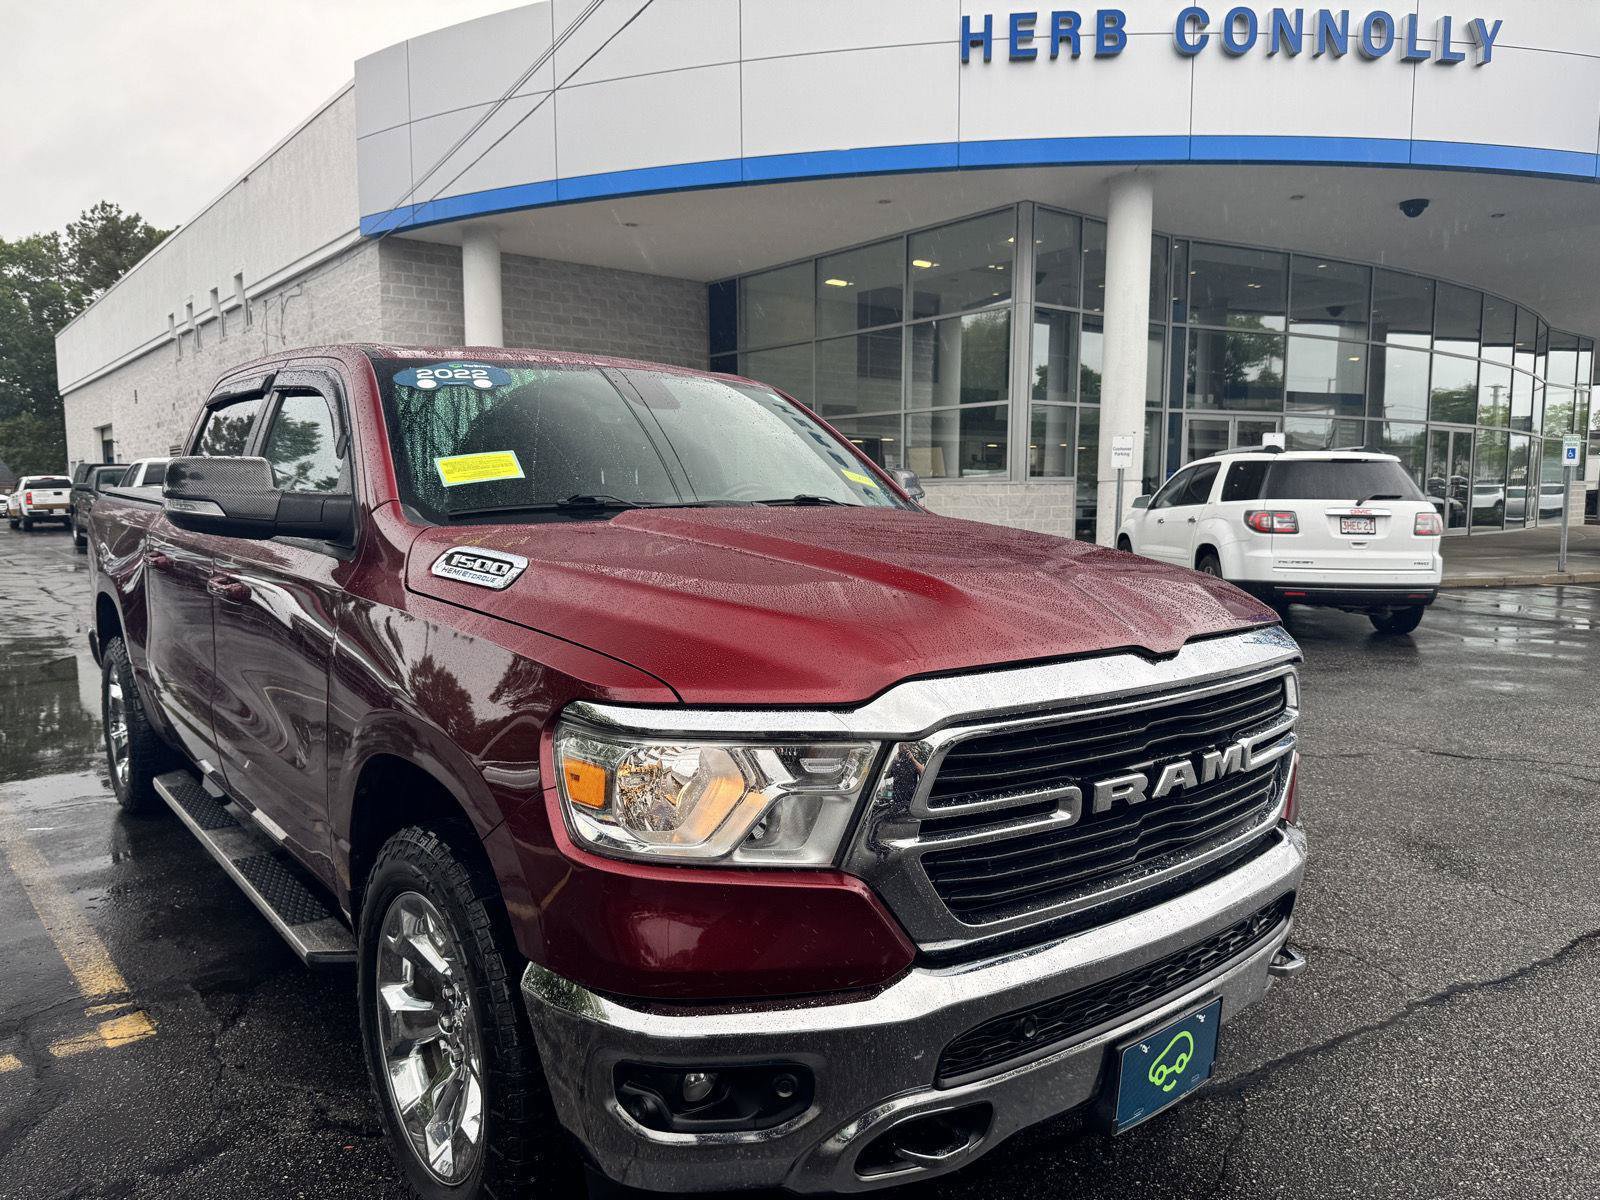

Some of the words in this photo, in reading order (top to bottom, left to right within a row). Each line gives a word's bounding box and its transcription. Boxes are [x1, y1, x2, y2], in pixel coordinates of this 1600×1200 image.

[961, 9, 1128, 63] HERB
[1173, 6, 1503, 66] CONNOLLY
[416, 368, 490, 380] 2022
[450, 554, 512, 576] 1500
[1093, 743, 1244, 815] RAM
